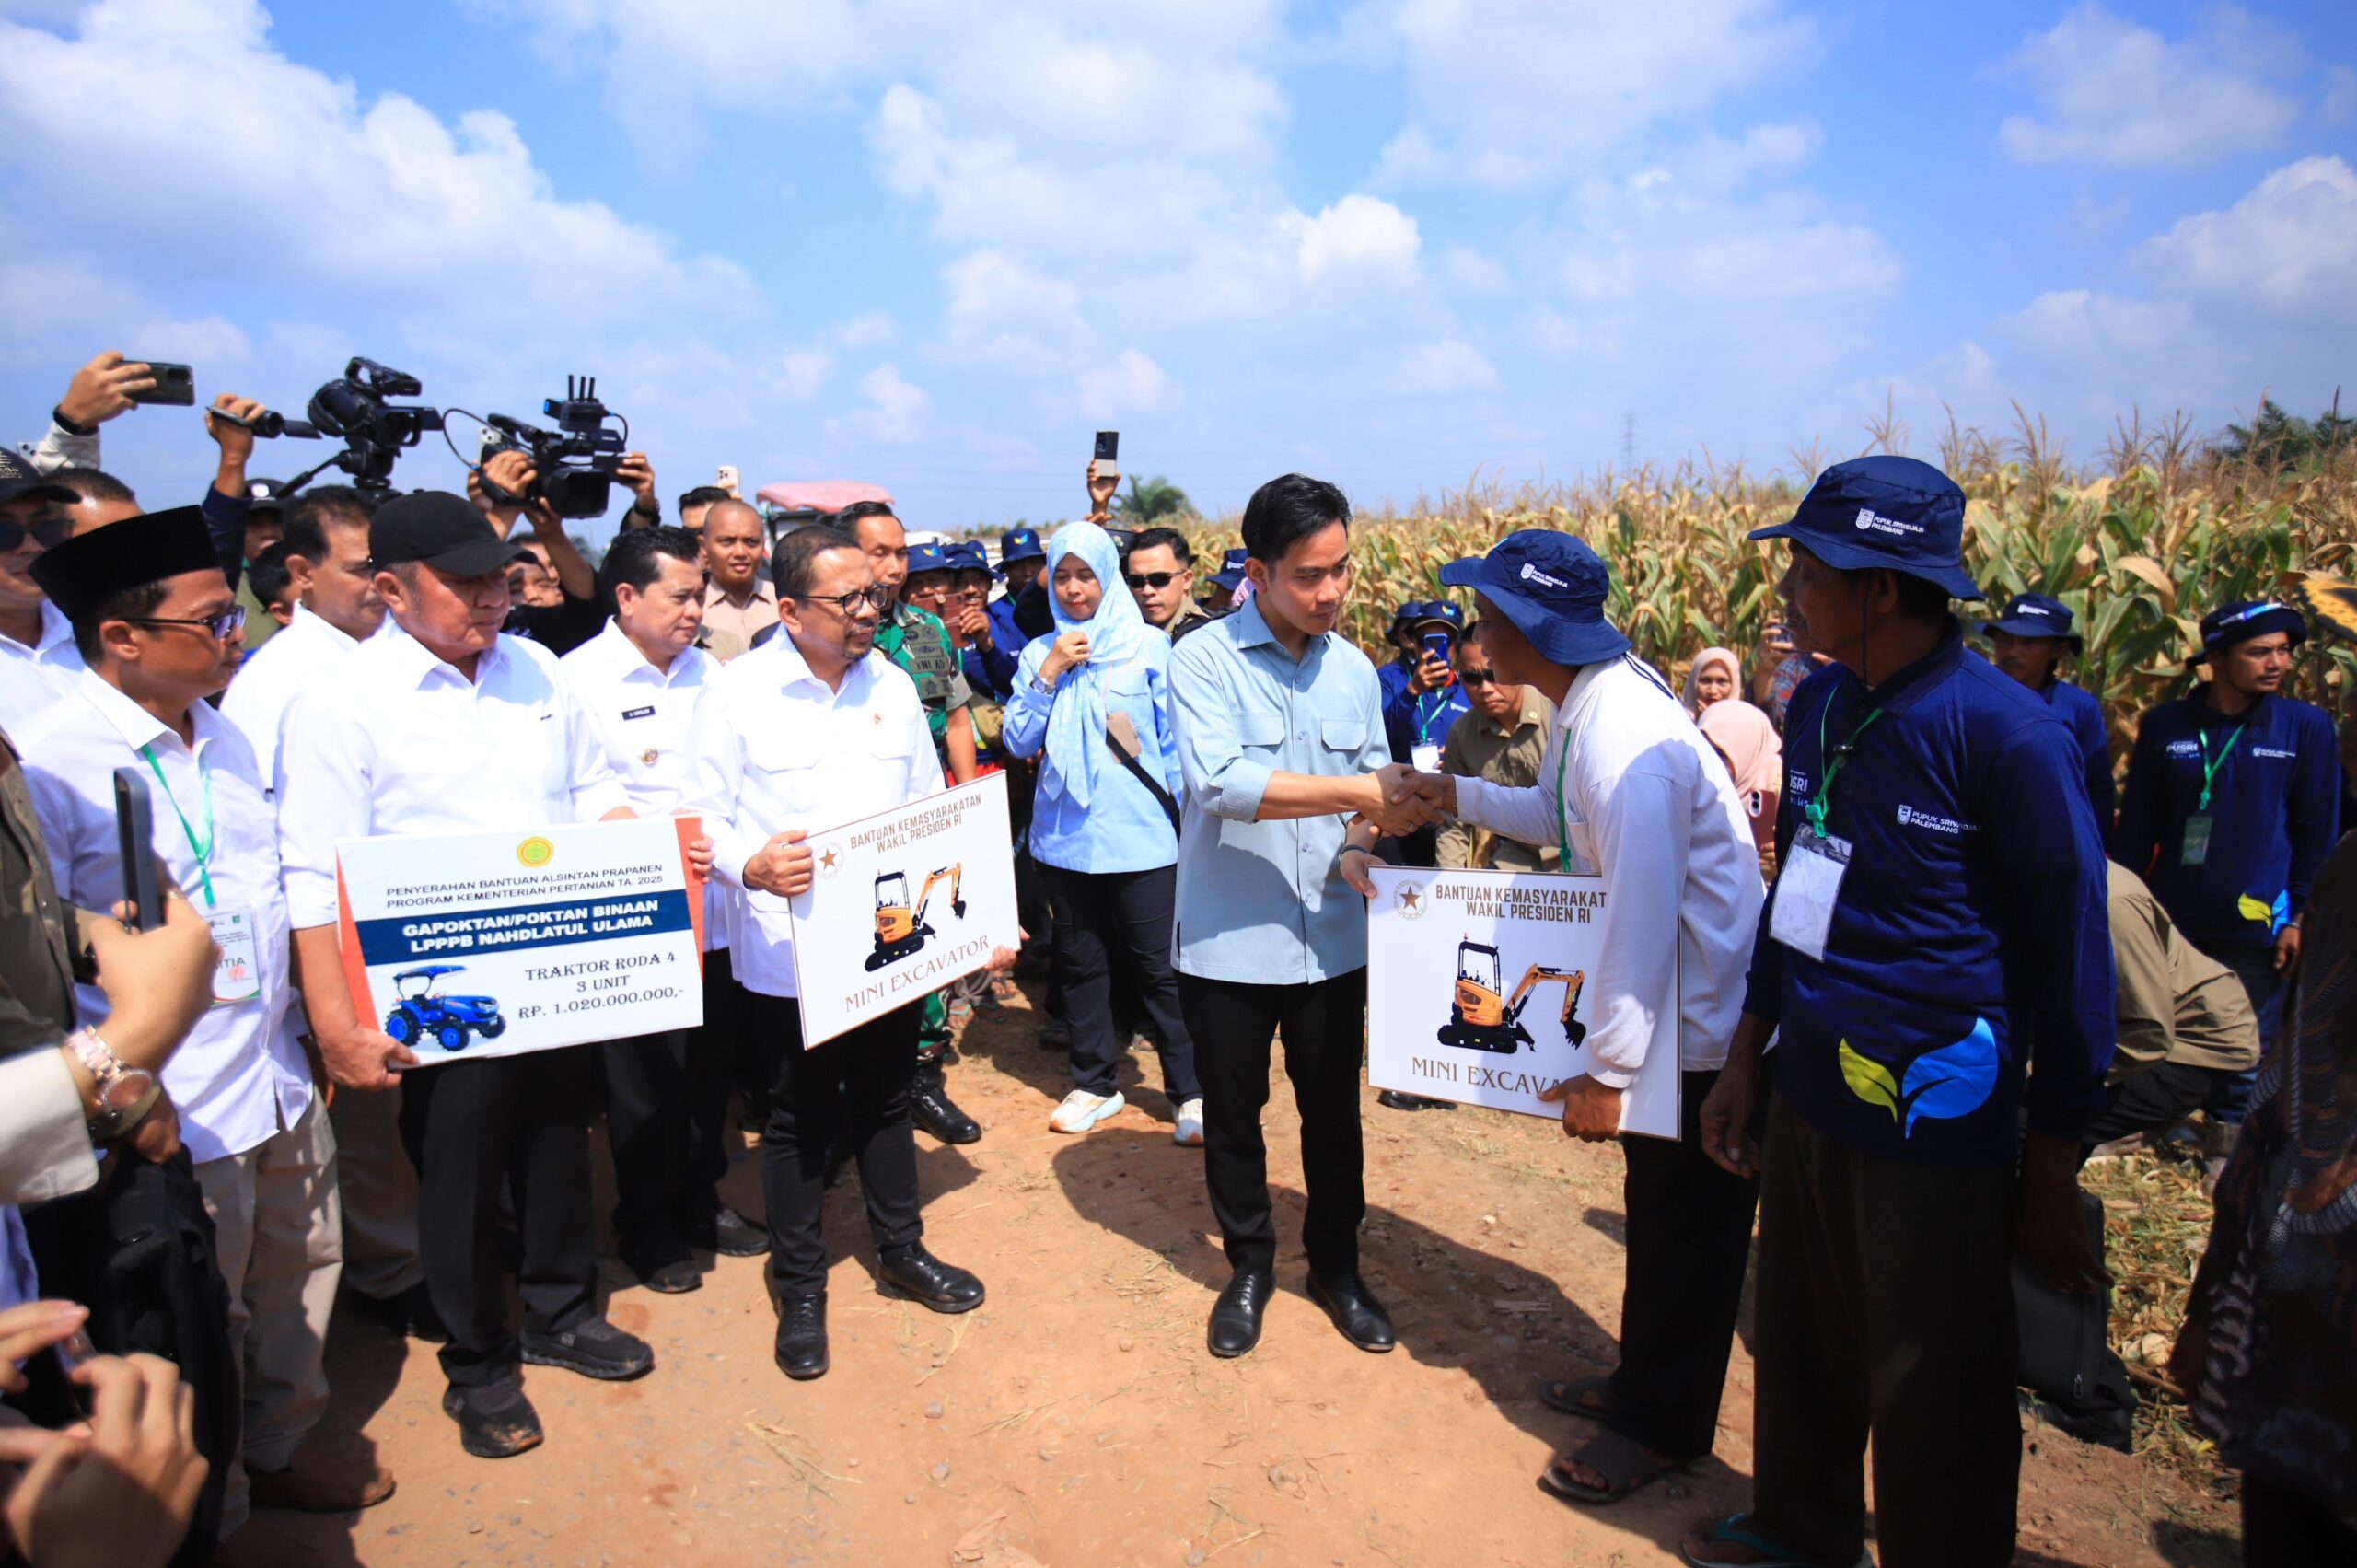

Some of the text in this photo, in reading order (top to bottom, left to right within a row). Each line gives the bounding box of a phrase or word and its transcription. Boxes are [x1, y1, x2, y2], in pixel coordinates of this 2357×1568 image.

[851, 794, 981, 849] BANTUAN KEMASYARAKATAN
[1910, 818, 1959, 834] PALEMBANG
[1912, 811, 1938, 823] PUPUK
[877, 814, 962, 854] WAKIL PRESIDEN RI
[387, 865, 663, 896] PENYERAHAN BANTUAN ALSINTAN PRAPANEN
[387, 875, 664, 908] PROGRAM KEMENTERIAN PERTANIAN TA. 2025
[1435, 885, 1608, 908] BANTUAN KEMASYARAKAT
[402, 900, 659, 937] GAPOKTAN/POKTAN BINAAN
[1466, 902, 1591, 923] WAKIL PRESIDEN RI
[411, 914, 654, 953] LPPPB NAHDLATUL ULAMA
[525, 951, 676, 981] TRAKTOR RODA 4
[844, 935, 990, 1013] MINI EXCAVATOR
[576, 975, 631, 993] 3 UNIT
[518, 987, 685, 1019] RP. 1.020.000.000,-
[1412, 1057, 1457, 1082] MINI
